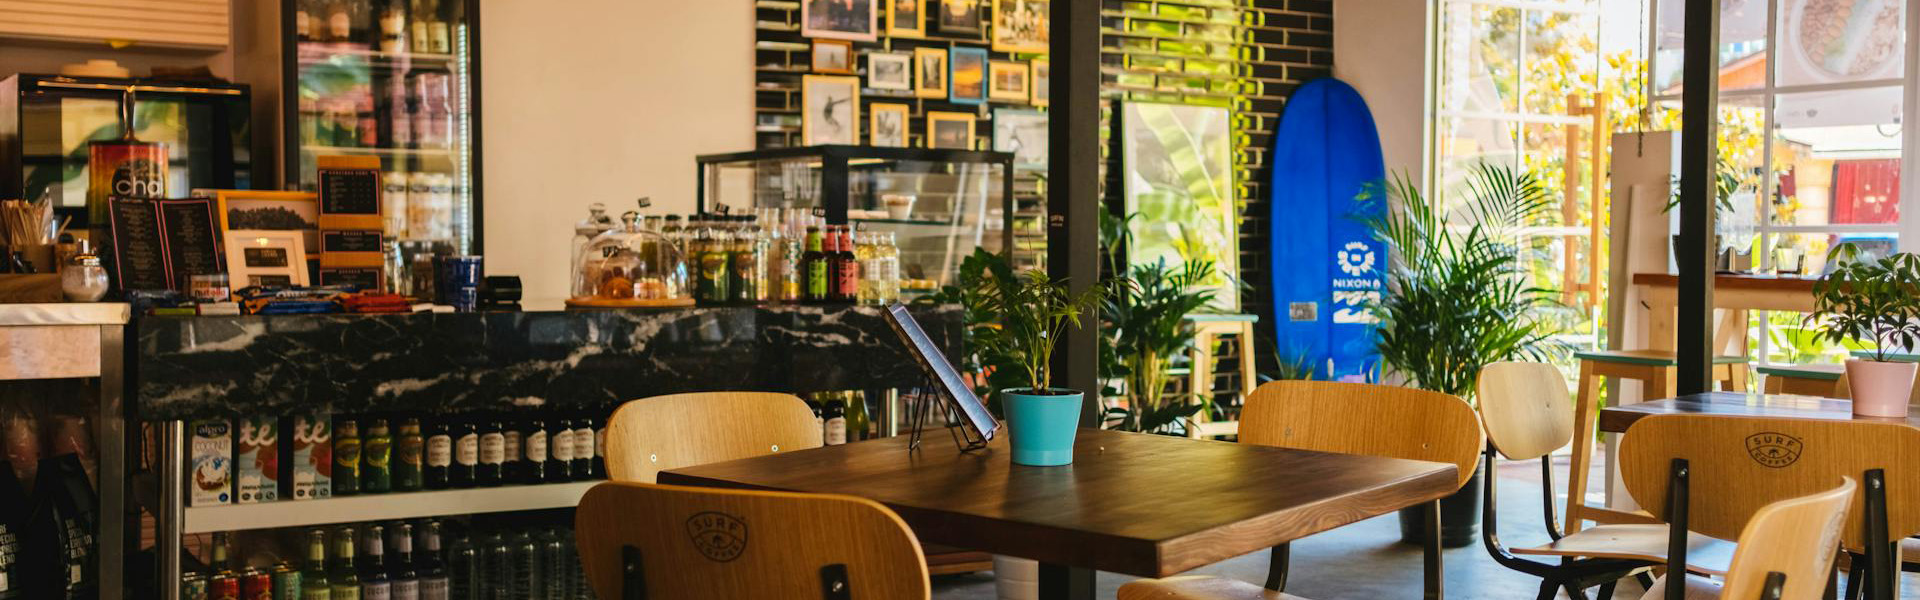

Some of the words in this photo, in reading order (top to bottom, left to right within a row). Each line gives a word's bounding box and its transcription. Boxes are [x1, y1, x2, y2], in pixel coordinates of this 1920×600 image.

[1333, 279, 1371, 288] NIXON
[199, 424, 226, 437] alpro
[1753, 435, 1795, 447] SURF
[694, 518, 738, 531] SURF
